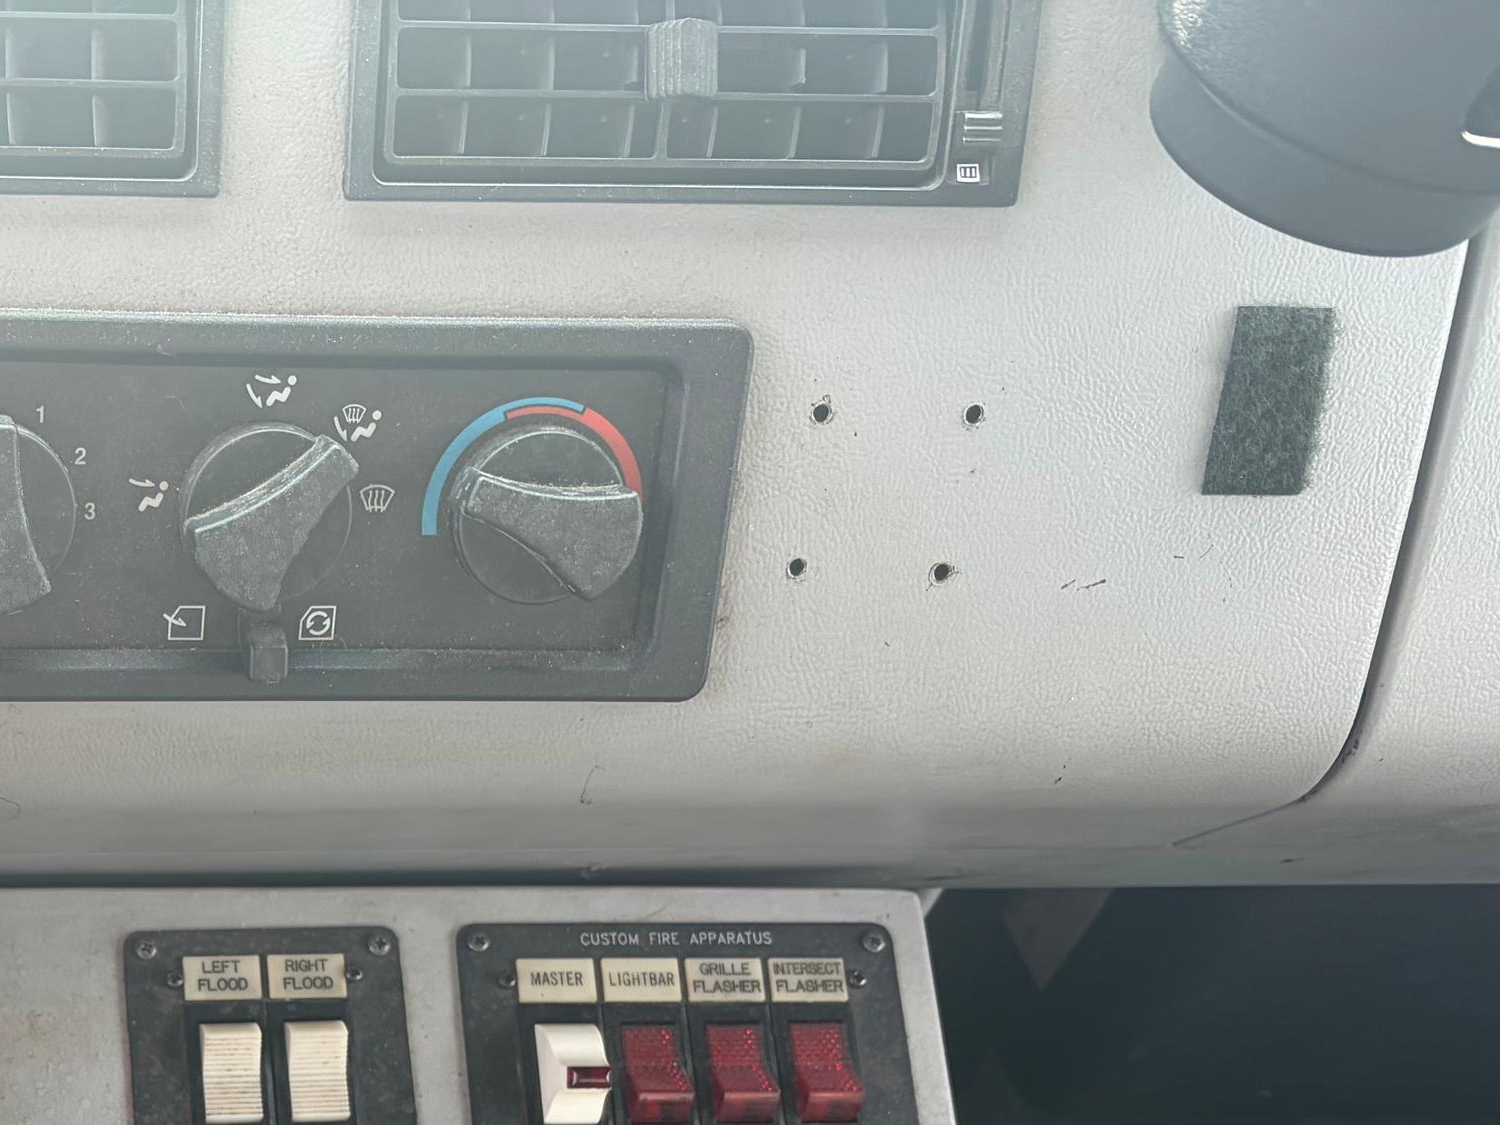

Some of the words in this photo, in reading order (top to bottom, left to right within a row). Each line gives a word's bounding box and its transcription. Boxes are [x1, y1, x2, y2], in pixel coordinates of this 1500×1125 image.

[36, 405, 45, 423] 1
[74, 447, 87, 465] 2
[84, 503, 96, 520] 3
[580, 932, 639, 947] CUSTOM
[649, 932, 680, 947] FIRE
[689, 931, 772, 946] APPARATUS
[202, 960, 241, 974] LEFT
[284, 959, 328, 972] RIGHT
[699, 961, 750, 976] GRILLE
[773, 961, 841, 976] INTERSECT
[198, 978, 248, 991] FLOOD
[283, 976, 333, 990] FLOOD
[530, 971, 583, 988] MASTER
[609, 971, 675, 988] LIGHTBAR
[693, 979, 762, 994] FLASHER
[775, 979, 844, 994] FLASHER
